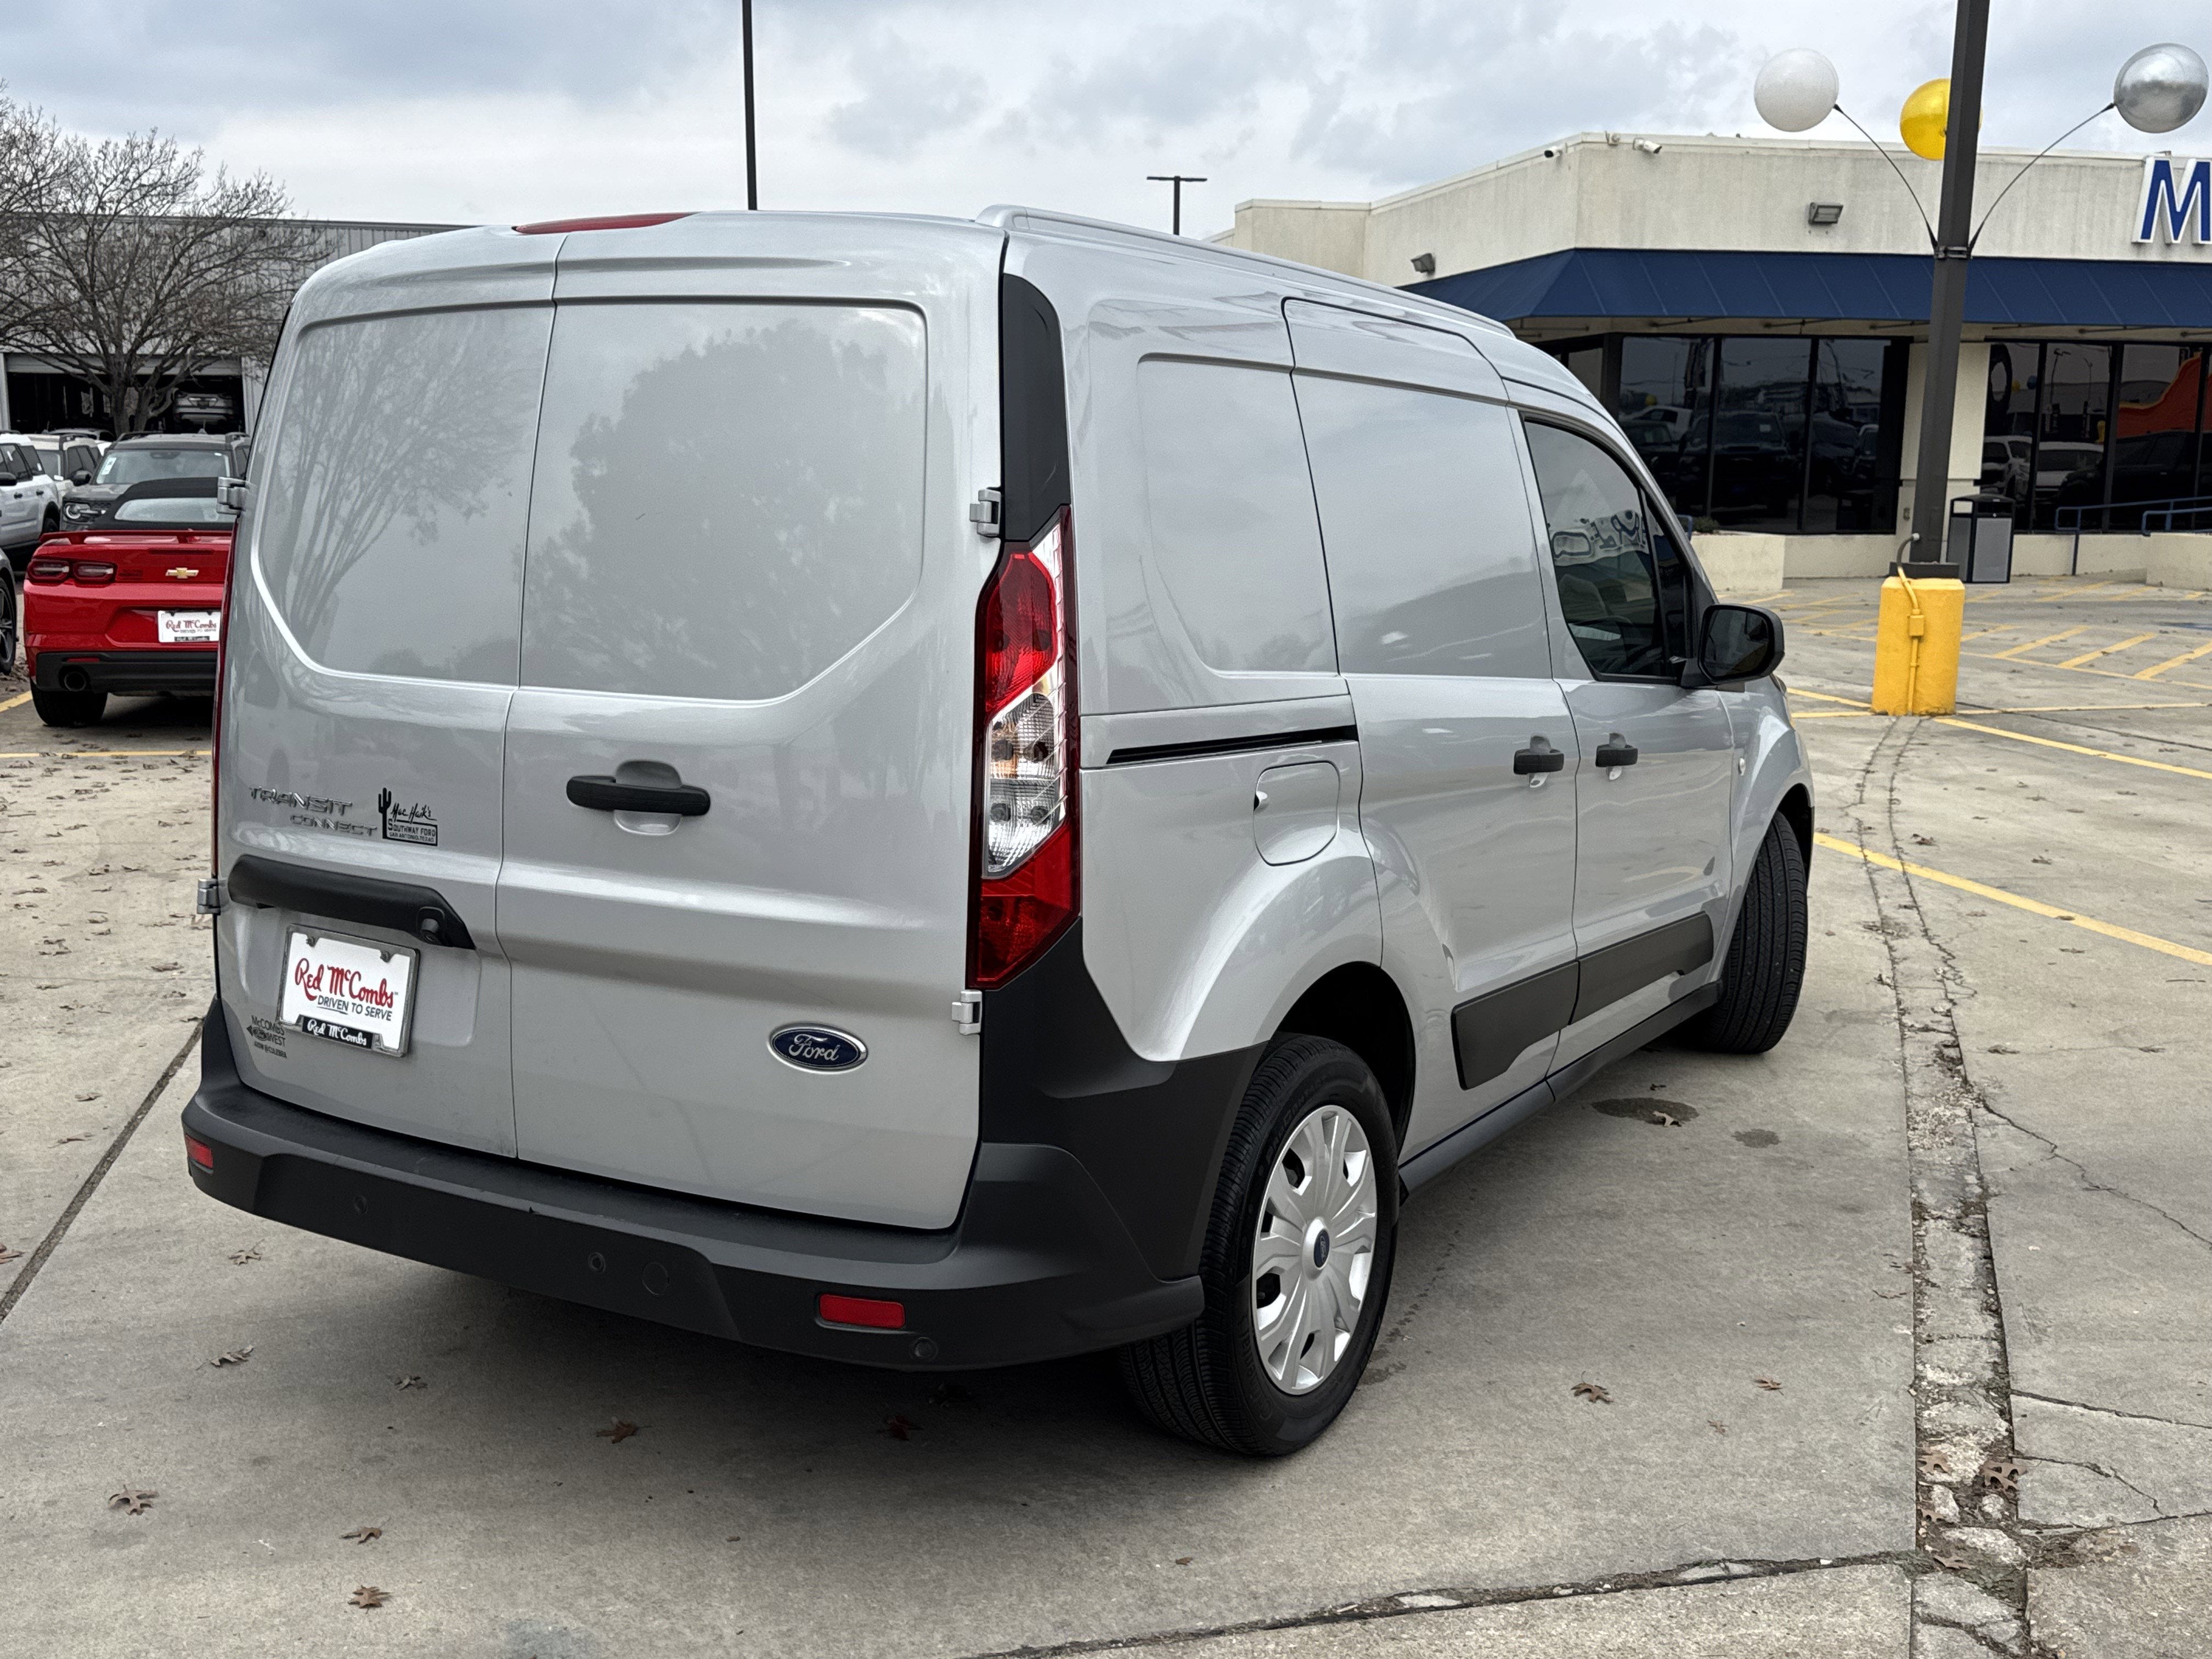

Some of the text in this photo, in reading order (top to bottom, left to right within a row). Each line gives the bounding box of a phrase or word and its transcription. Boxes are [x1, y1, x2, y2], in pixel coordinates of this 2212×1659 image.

[250, 786, 353, 816] TRANSIT
[290, 815, 377, 835] CONNECT
[295, 957, 394, 1008] Red McCombs
[318, 995, 392, 1022] DRIVEN TO SERVE
[307, 1019, 367, 1046] Red McCombs
[788, 1034, 840, 1061] Ford
